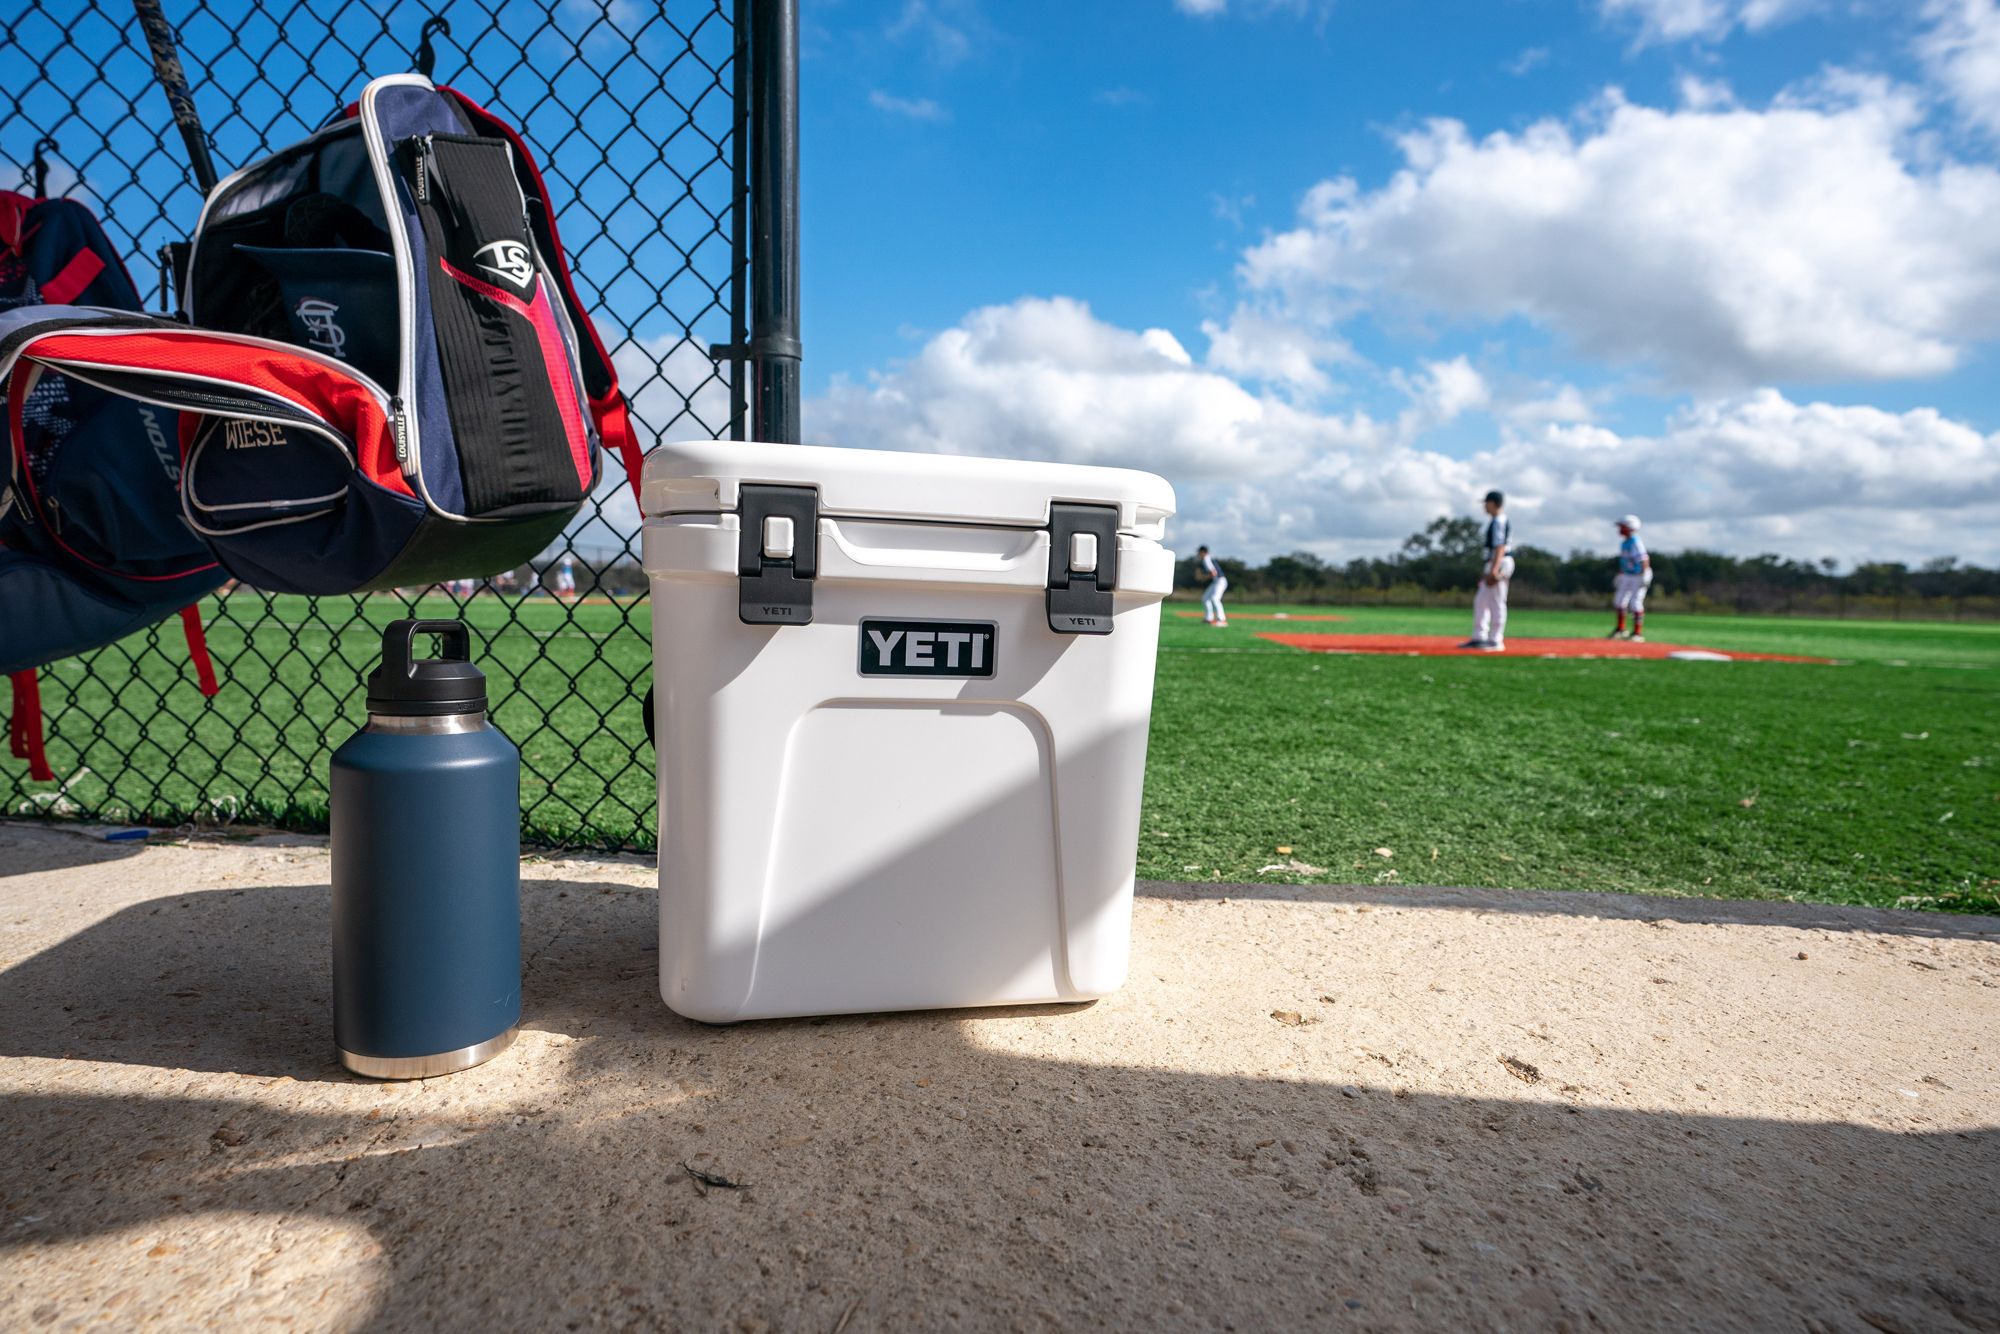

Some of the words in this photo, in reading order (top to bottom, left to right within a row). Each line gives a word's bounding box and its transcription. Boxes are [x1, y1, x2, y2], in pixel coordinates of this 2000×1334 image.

[415, 156, 425, 200] LOUISVILLE
[138, 407, 182, 490] STON
[224, 420, 288, 450] WIESE
[397, 415, 406, 458] LOUISVILLE
[762, 606, 792, 616] YETI
[1069, 617, 1096, 626] YETI
[867, 629, 984, 668] YETI
